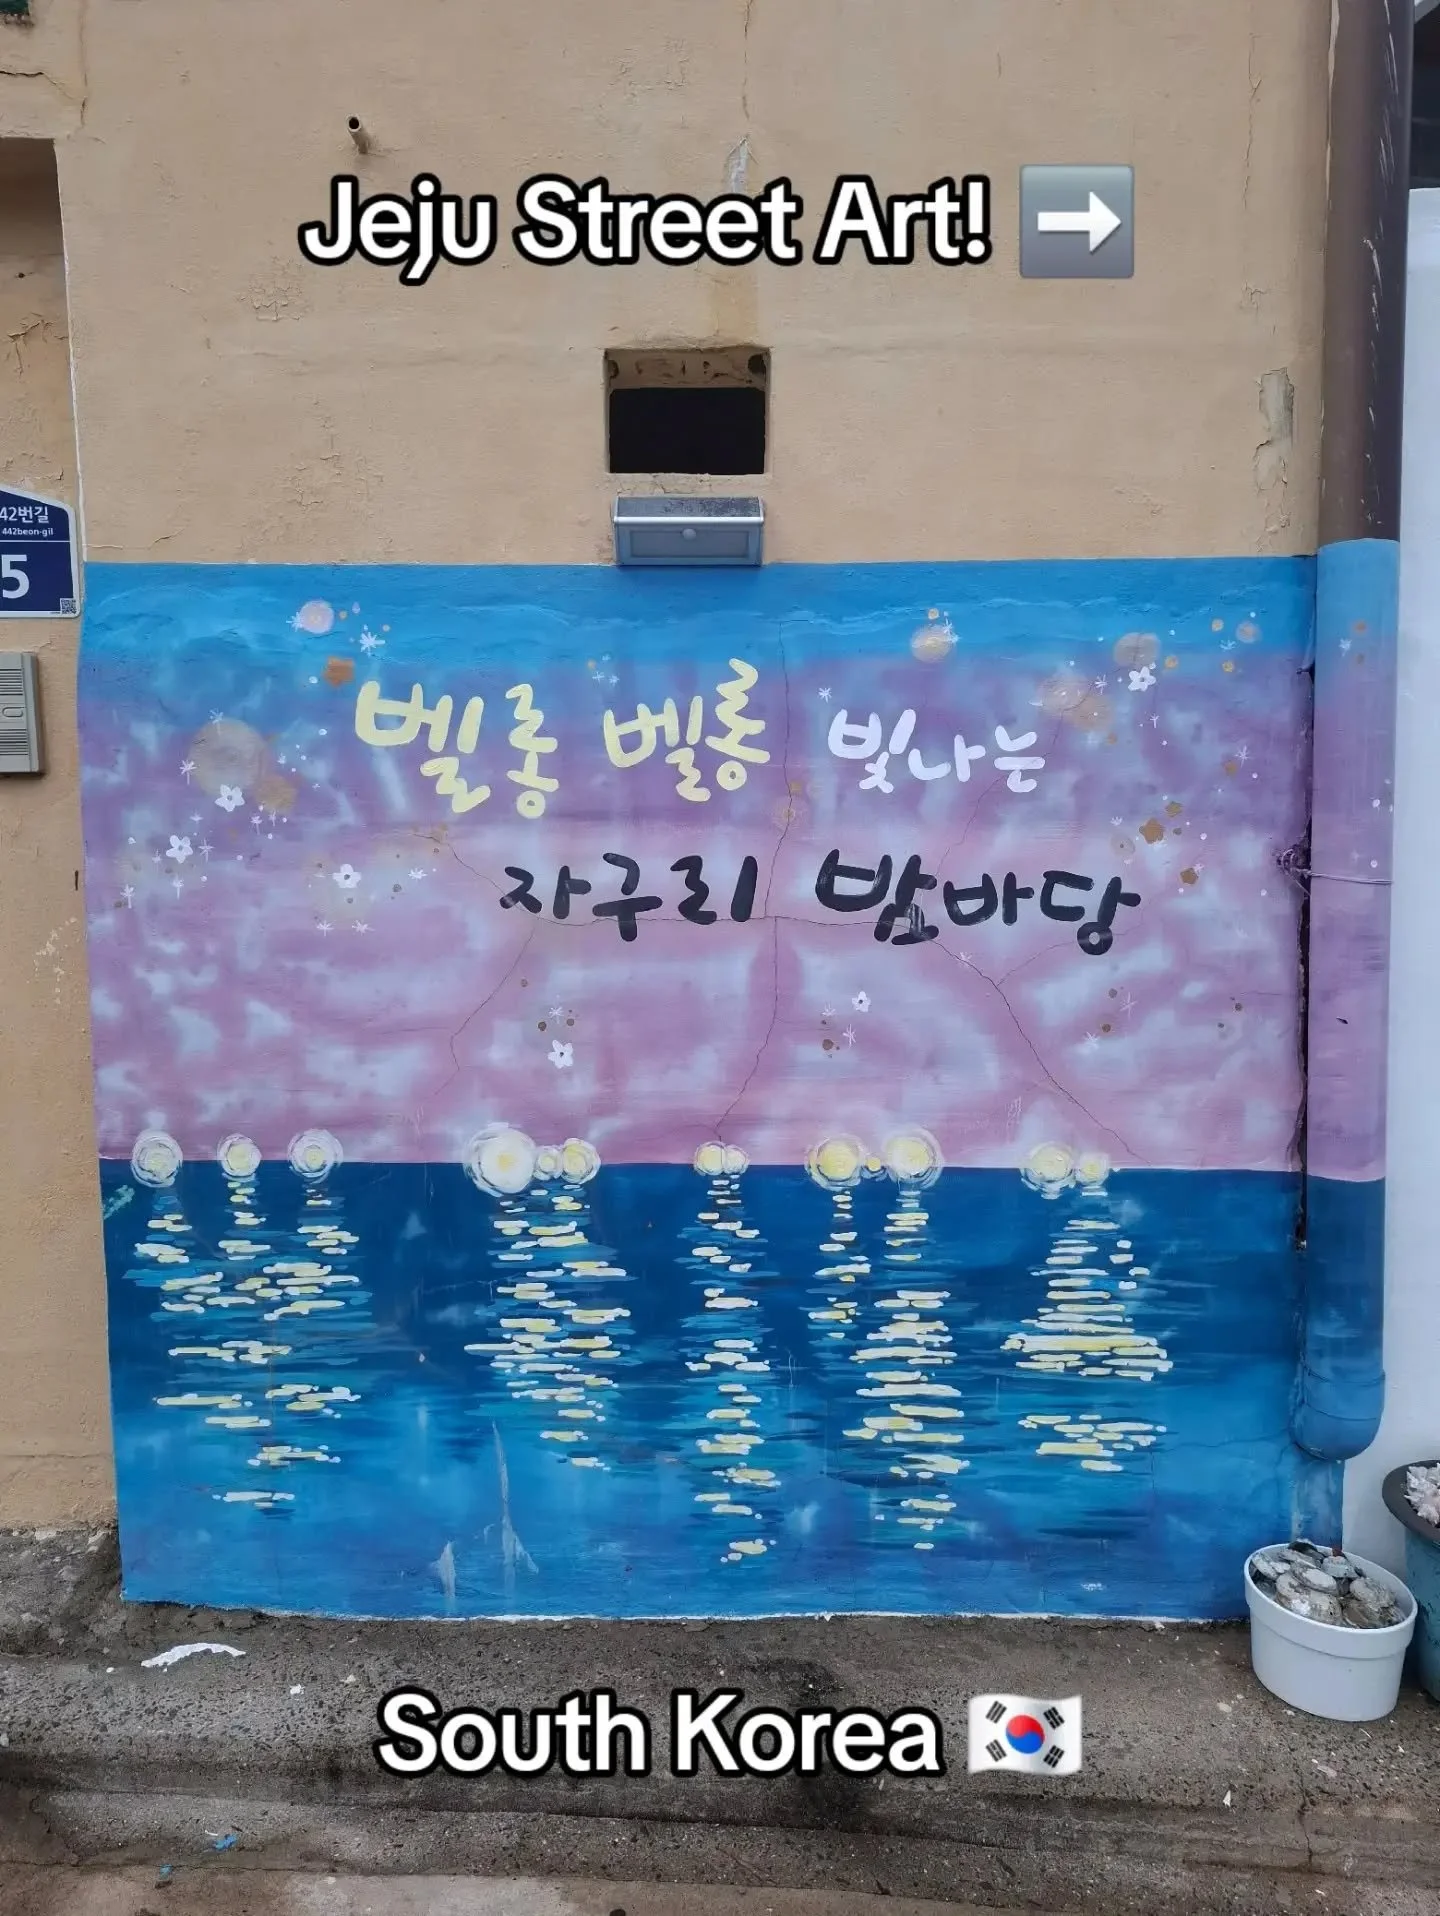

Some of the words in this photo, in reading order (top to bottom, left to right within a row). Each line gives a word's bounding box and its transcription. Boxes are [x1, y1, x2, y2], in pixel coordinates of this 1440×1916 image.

[0, 506, 49, 523] 42번길
[2, 527, 54, 537] 442beon-gil
[1, 554, 30, 599] 5
[356, 682, 559, 819] 벨롱
[604, 658, 770, 802] 벨롱
[828, 709, 1045, 794] 빛나는
[500, 852, 758, 942] 자구리
[814, 848, 1142, 956] 밤바당
